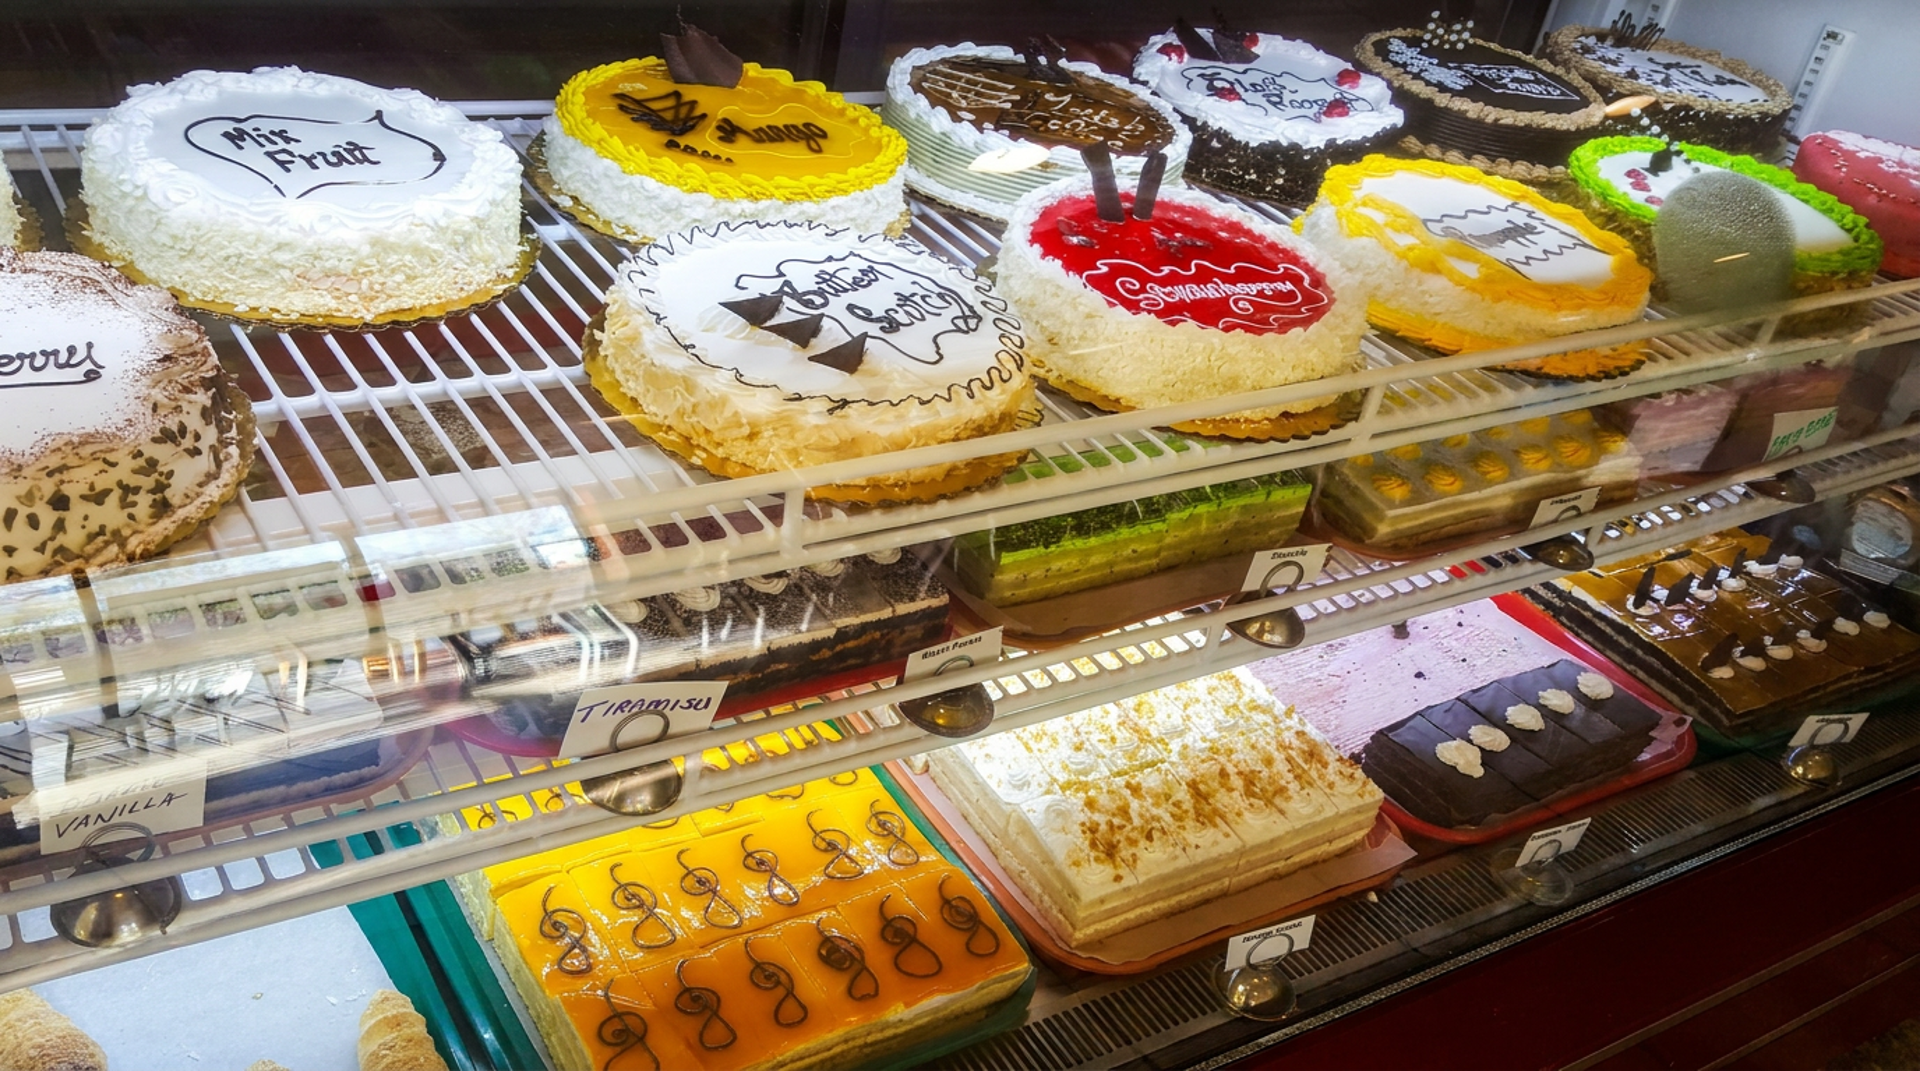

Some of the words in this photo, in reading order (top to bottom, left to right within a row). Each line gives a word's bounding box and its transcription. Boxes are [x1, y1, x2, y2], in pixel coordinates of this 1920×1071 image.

[220, 126, 302, 150] Mix
[263, 140, 382, 173] Fruit
[577, 696, 712, 724] TIRAMISU
[55, 791, 188, 839] VANILLA
